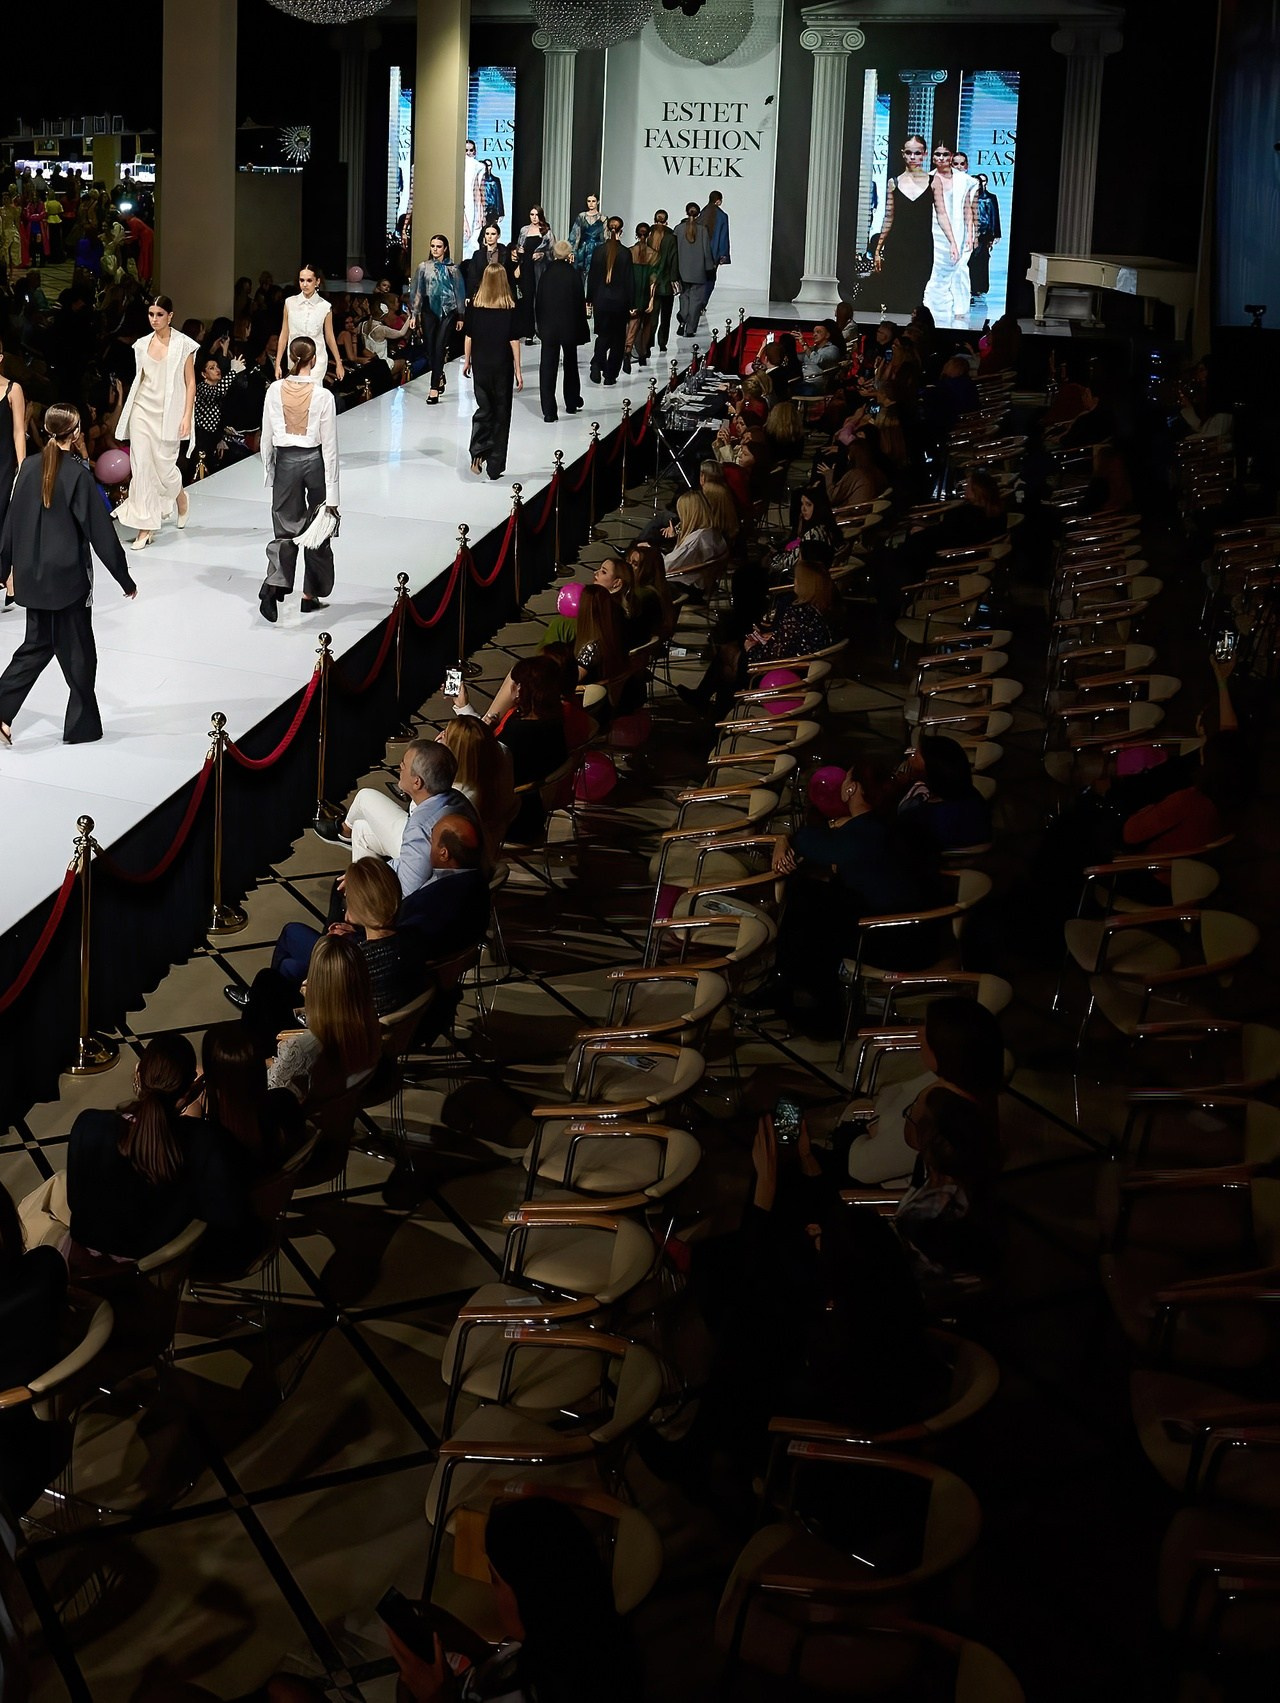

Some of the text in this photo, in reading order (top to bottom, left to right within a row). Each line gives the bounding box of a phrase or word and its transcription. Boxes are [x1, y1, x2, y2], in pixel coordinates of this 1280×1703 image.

[662, 101, 749, 123] ESTET
[483, 137, 515, 151] FAS
[643, 128, 765, 151] FASHION
[495, 156, 510, 170] W
[977, 149, 1015, 165] FAS
[661, 155, 745, 178] WEEK
[991, 171, 1011, 187] W
